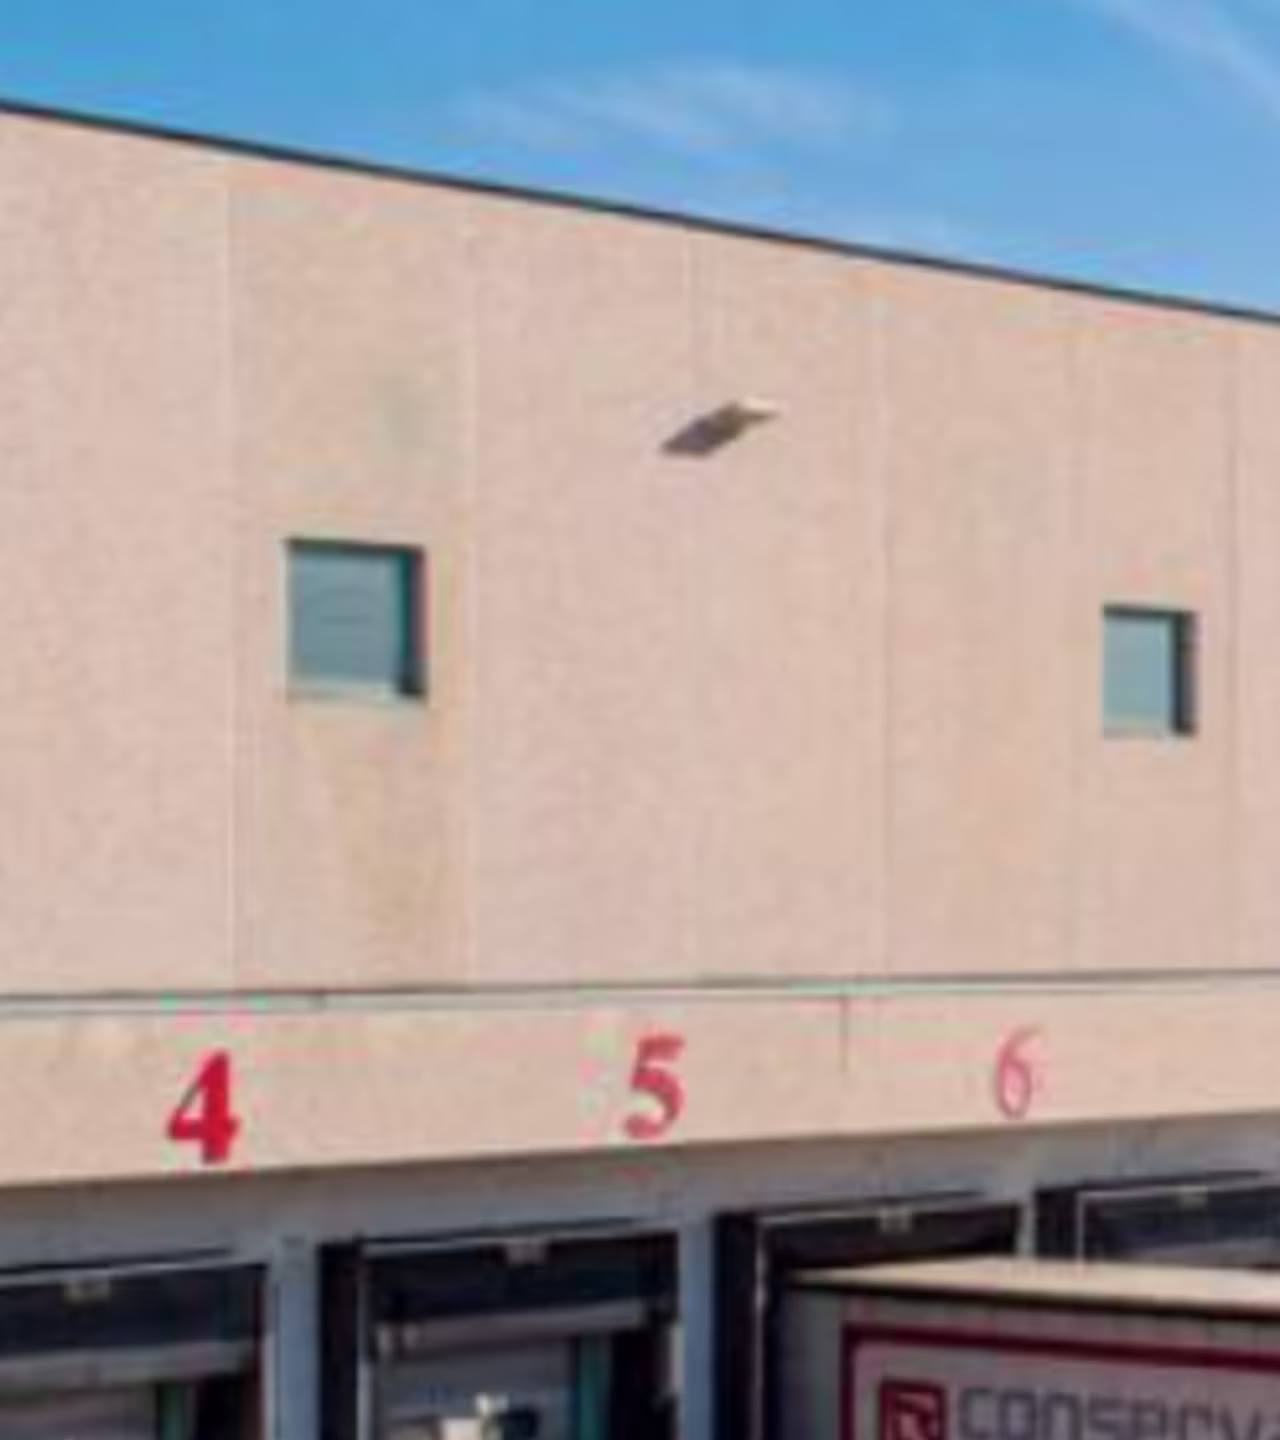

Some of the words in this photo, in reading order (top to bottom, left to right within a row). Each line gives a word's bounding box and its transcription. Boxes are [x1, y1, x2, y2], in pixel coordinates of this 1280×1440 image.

[165, 1050, 241, 1164] 4
[622, 1034, 686, 1138] 5
[994, 1026, 1042, 1120] 6
